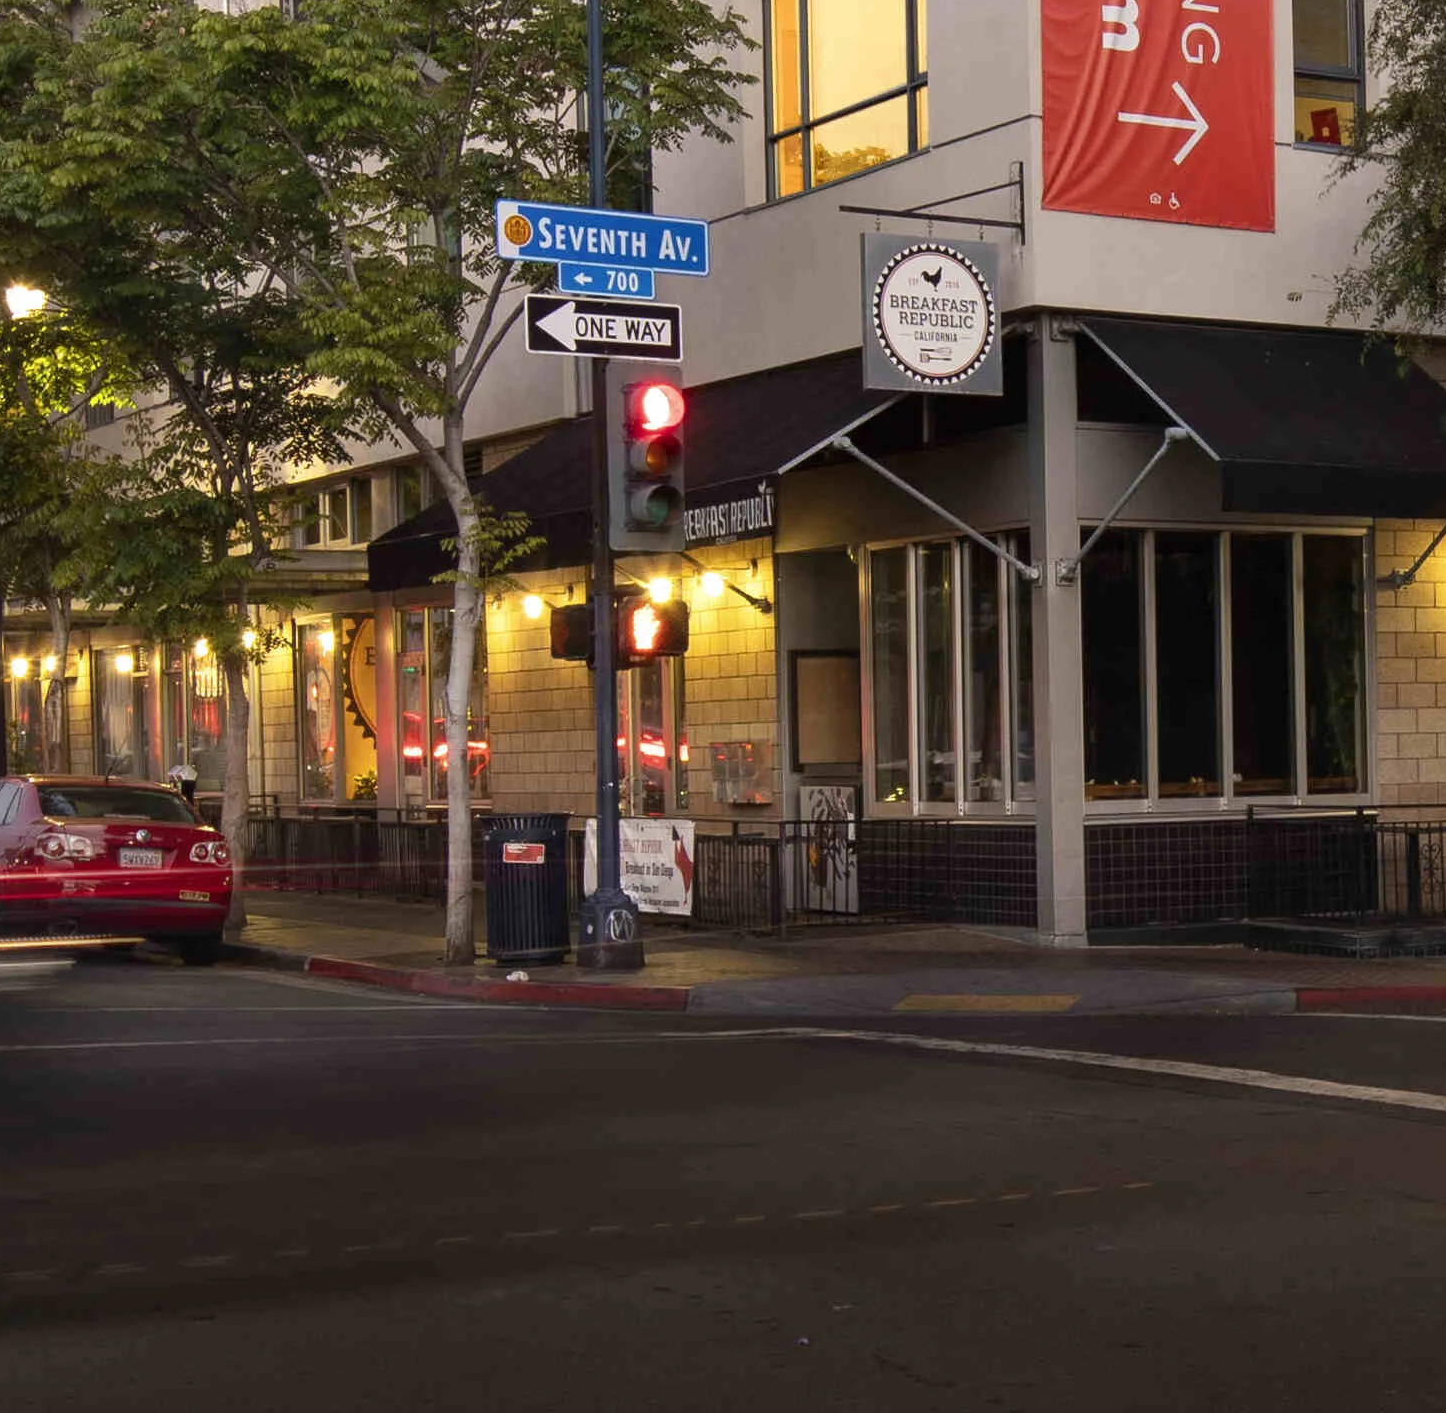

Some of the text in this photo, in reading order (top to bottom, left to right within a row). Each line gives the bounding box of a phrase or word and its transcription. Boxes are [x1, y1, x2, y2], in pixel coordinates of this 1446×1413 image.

[606, 270, 639, 293] 700
[889, 294, 978, 314] BREAKFAST
[575, 316, 666, 343] ONE WAY
[898, 311, 975, 330] REPUBLIC
[913, 330, 958, 343] CALIFORNIA
[684, 503, 729, 541] REAKFAST
